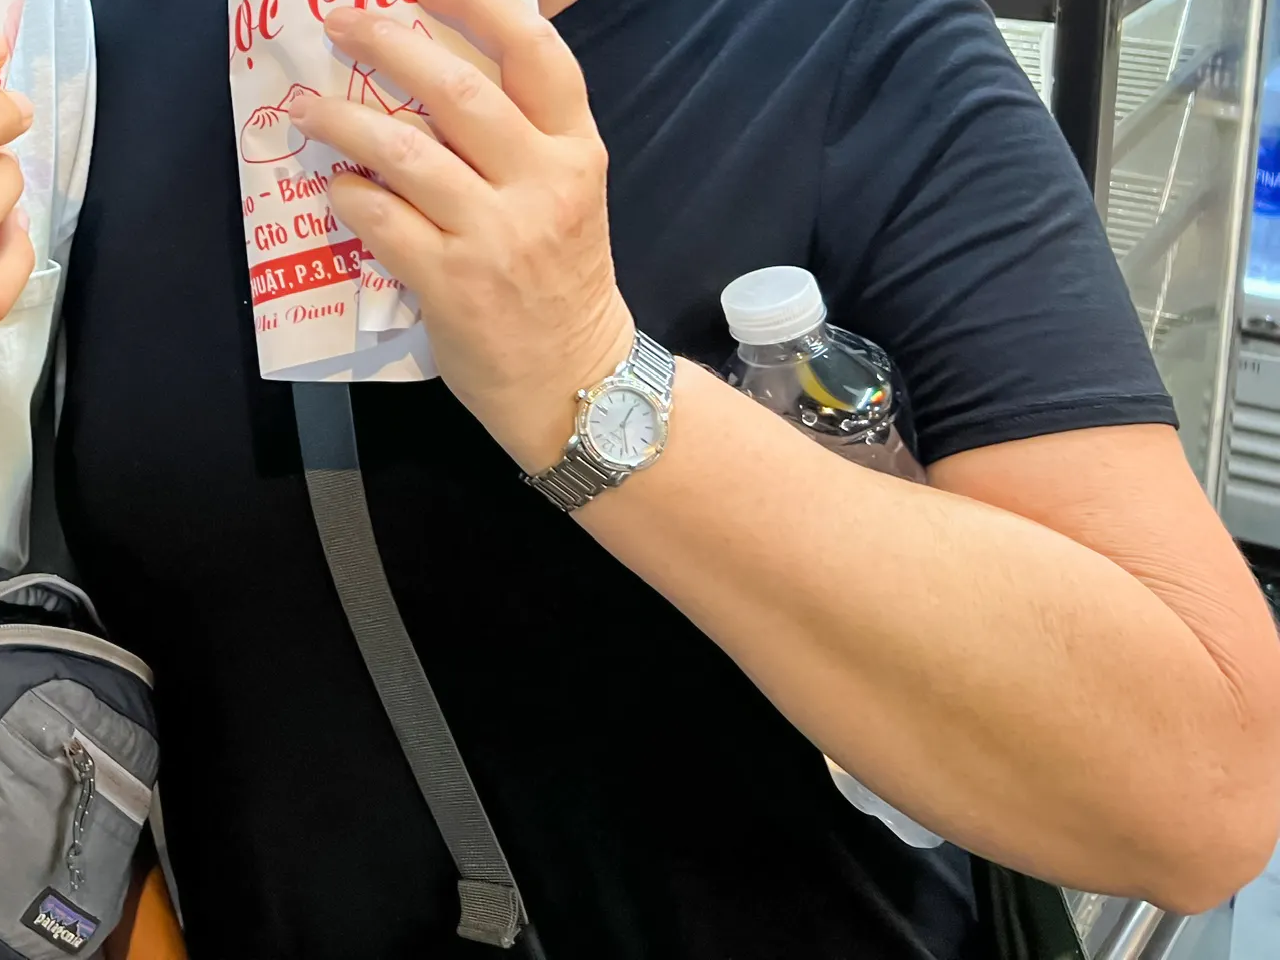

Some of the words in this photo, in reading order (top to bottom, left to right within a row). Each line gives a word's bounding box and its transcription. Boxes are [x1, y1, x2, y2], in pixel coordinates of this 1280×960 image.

[254, 221, 289, 251] Giò
[295, 260, 332, 284] P.3,
[33, 913, 85, 948] patagonia
